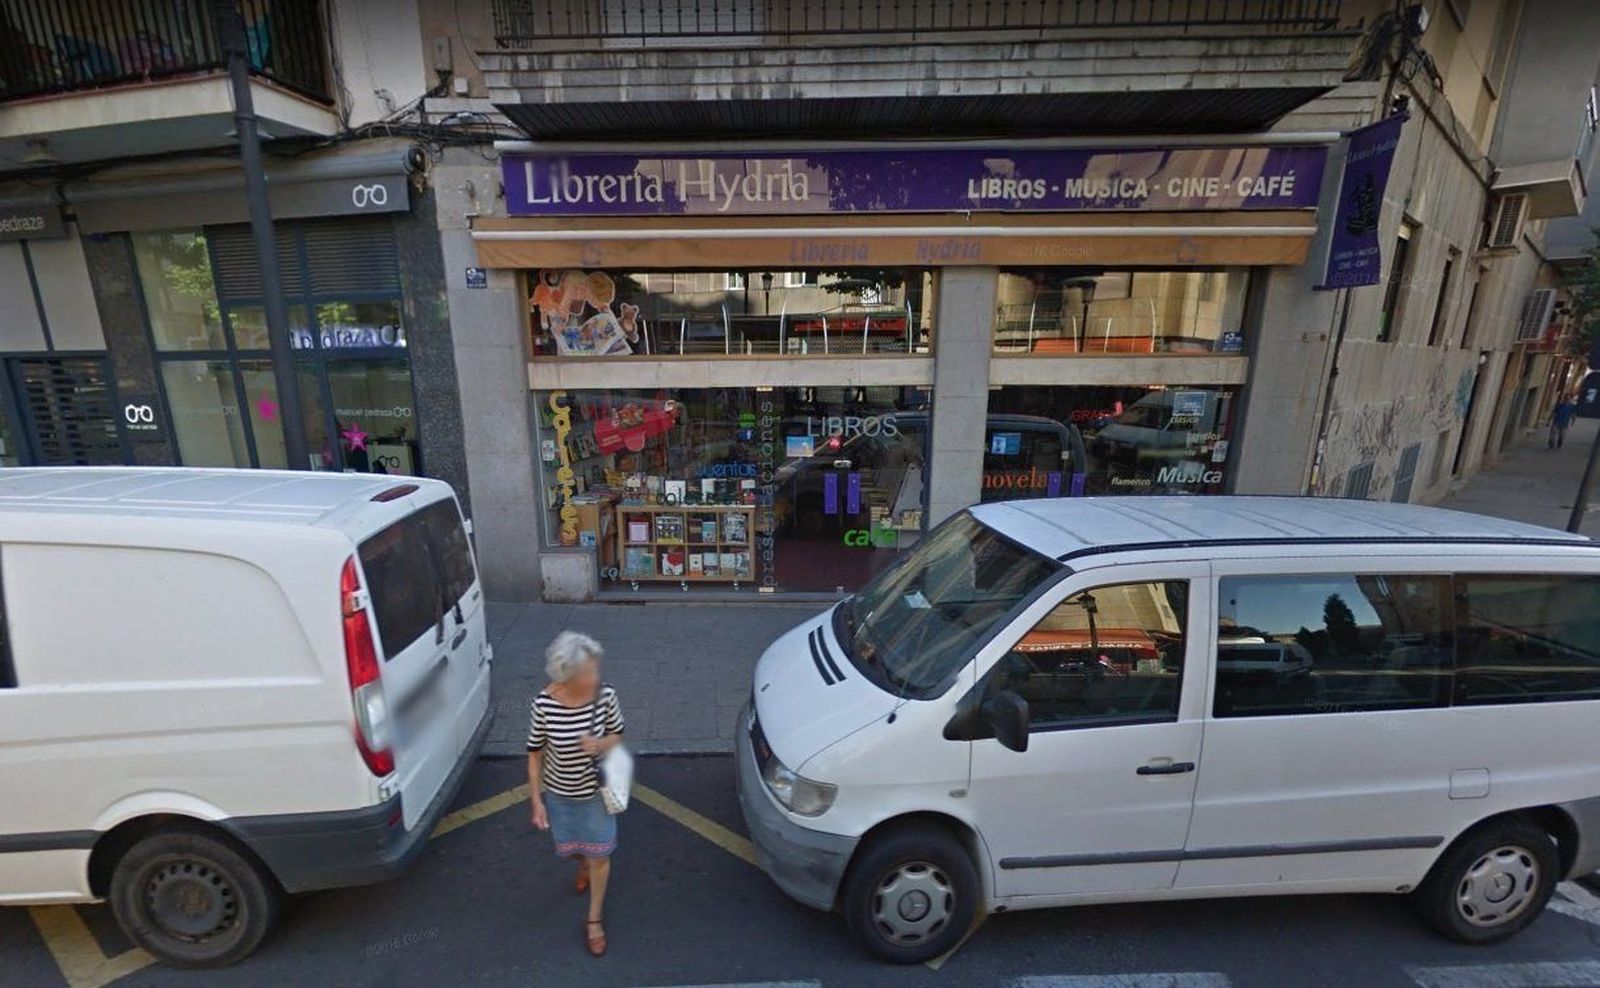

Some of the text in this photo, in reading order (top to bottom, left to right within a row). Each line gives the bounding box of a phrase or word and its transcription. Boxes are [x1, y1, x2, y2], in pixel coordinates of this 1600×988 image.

[967, 177, 1047, 199] LIBROS
[1167, 176, 1220, 198] CINE
[1237, 168, 1296, 197] CAFÉ
[0, 215, 44, 233] edraza
[807, 415, 898, 437] LIBROS
